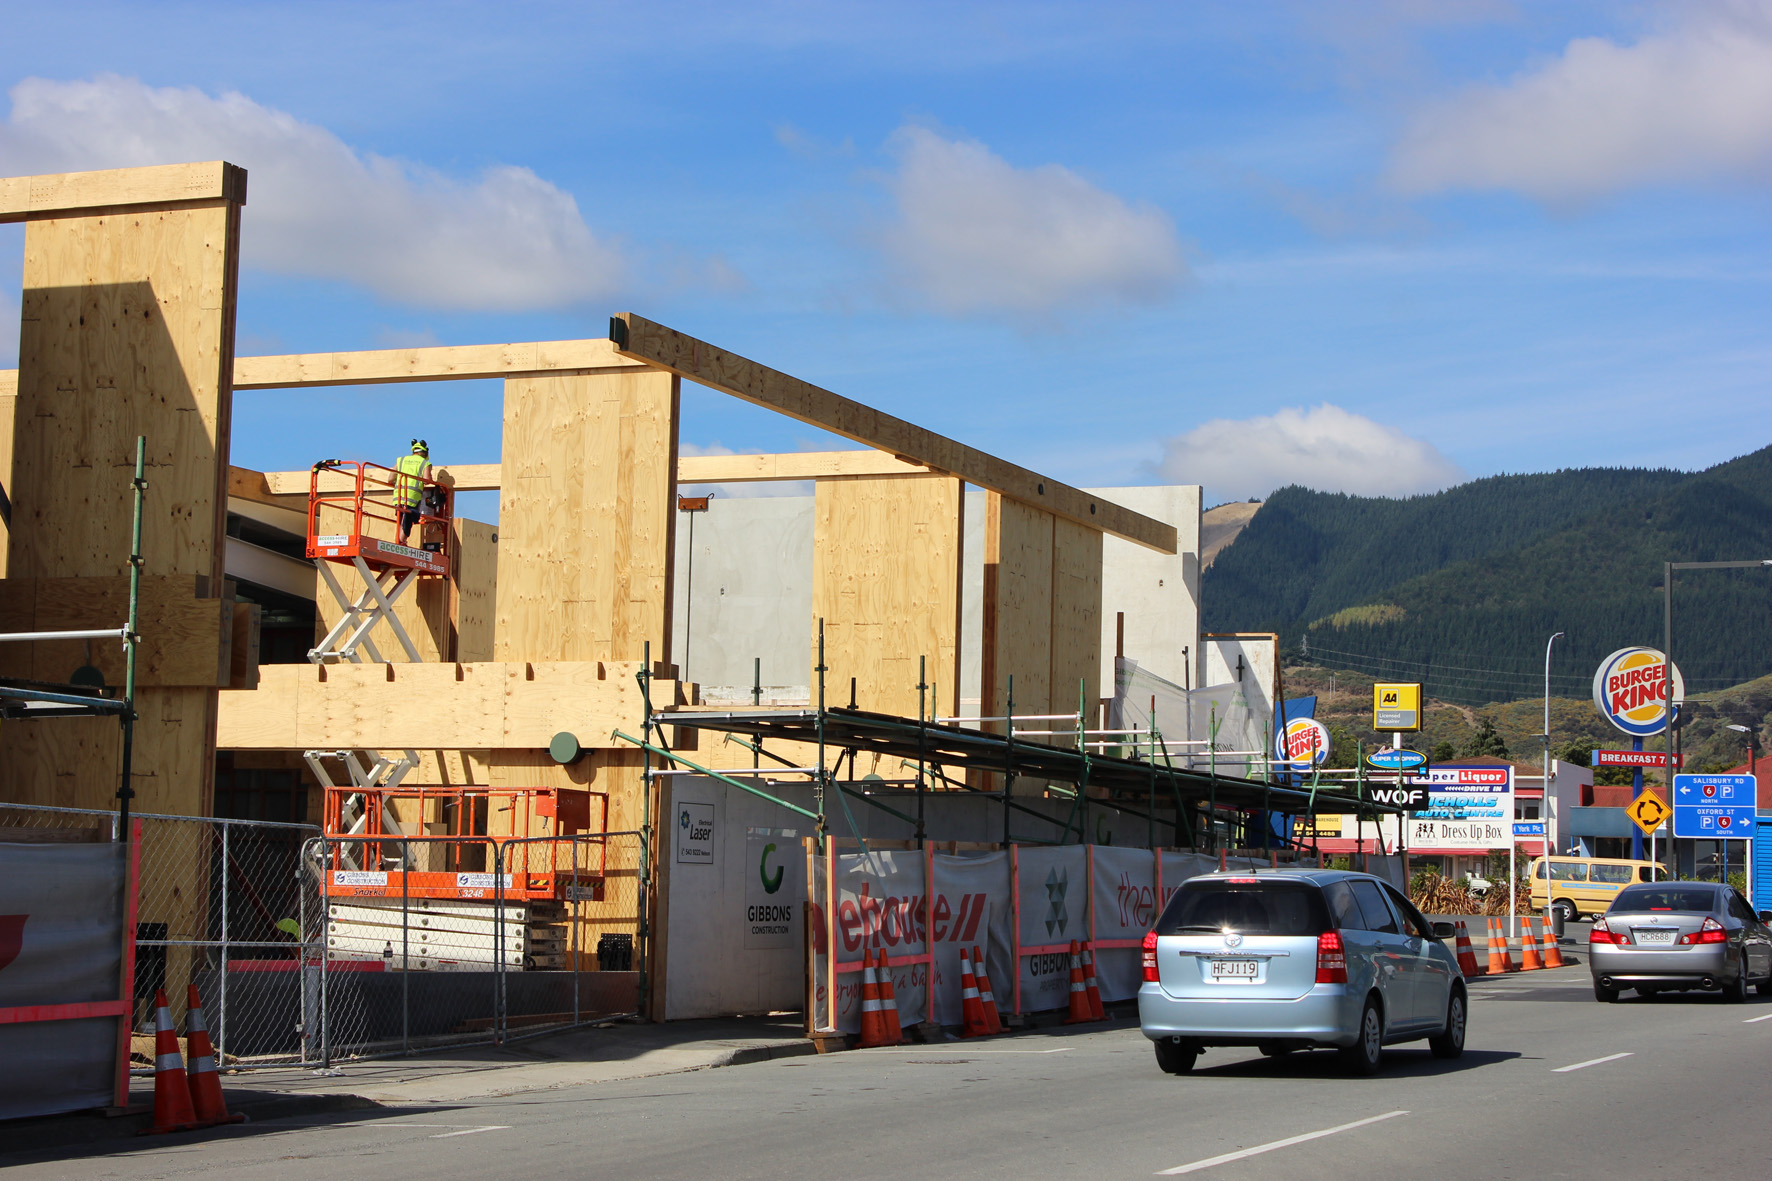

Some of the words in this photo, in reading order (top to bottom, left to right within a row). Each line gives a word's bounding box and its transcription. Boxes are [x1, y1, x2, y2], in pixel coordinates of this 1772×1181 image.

[306, 548, 315, 557] 54
[415, 560, 427, 569] 544
[429, 564, 445, 573] 3985
[1383, 693, 1397, 703] AA
[1612, 680, 1675, 715] KING
[1288, 735, 1322, 758] KING
[1601, 753, 1656, 764] BREAKFAST
[1460, 770, 1502, 783] Liquor
[1371, 789, 1423, 805] WOF
[1428, 796, 1498, 807] ICHOLLS
[1415, 809, 1449, 817] AUTO
[1454, 809, 1504, 818] CENTRE
[1721, 818, 1727, 826] 6
[689, 824, 712, 841] Laser
[1441, 824, 1467, 839] Dress
[1470, 824, 1482, 841] Up
[1485, 824, 1503, 839] Box
[747, 905, 792, 922] GIBBONS
[752, 925, 789, 935] CONSTRUCTION
[1641, 932, 1670, 941] HCR688
[1030, 952, 1071, 977] GIBBON
[1213, 963, 1256, 974] HFJ119
